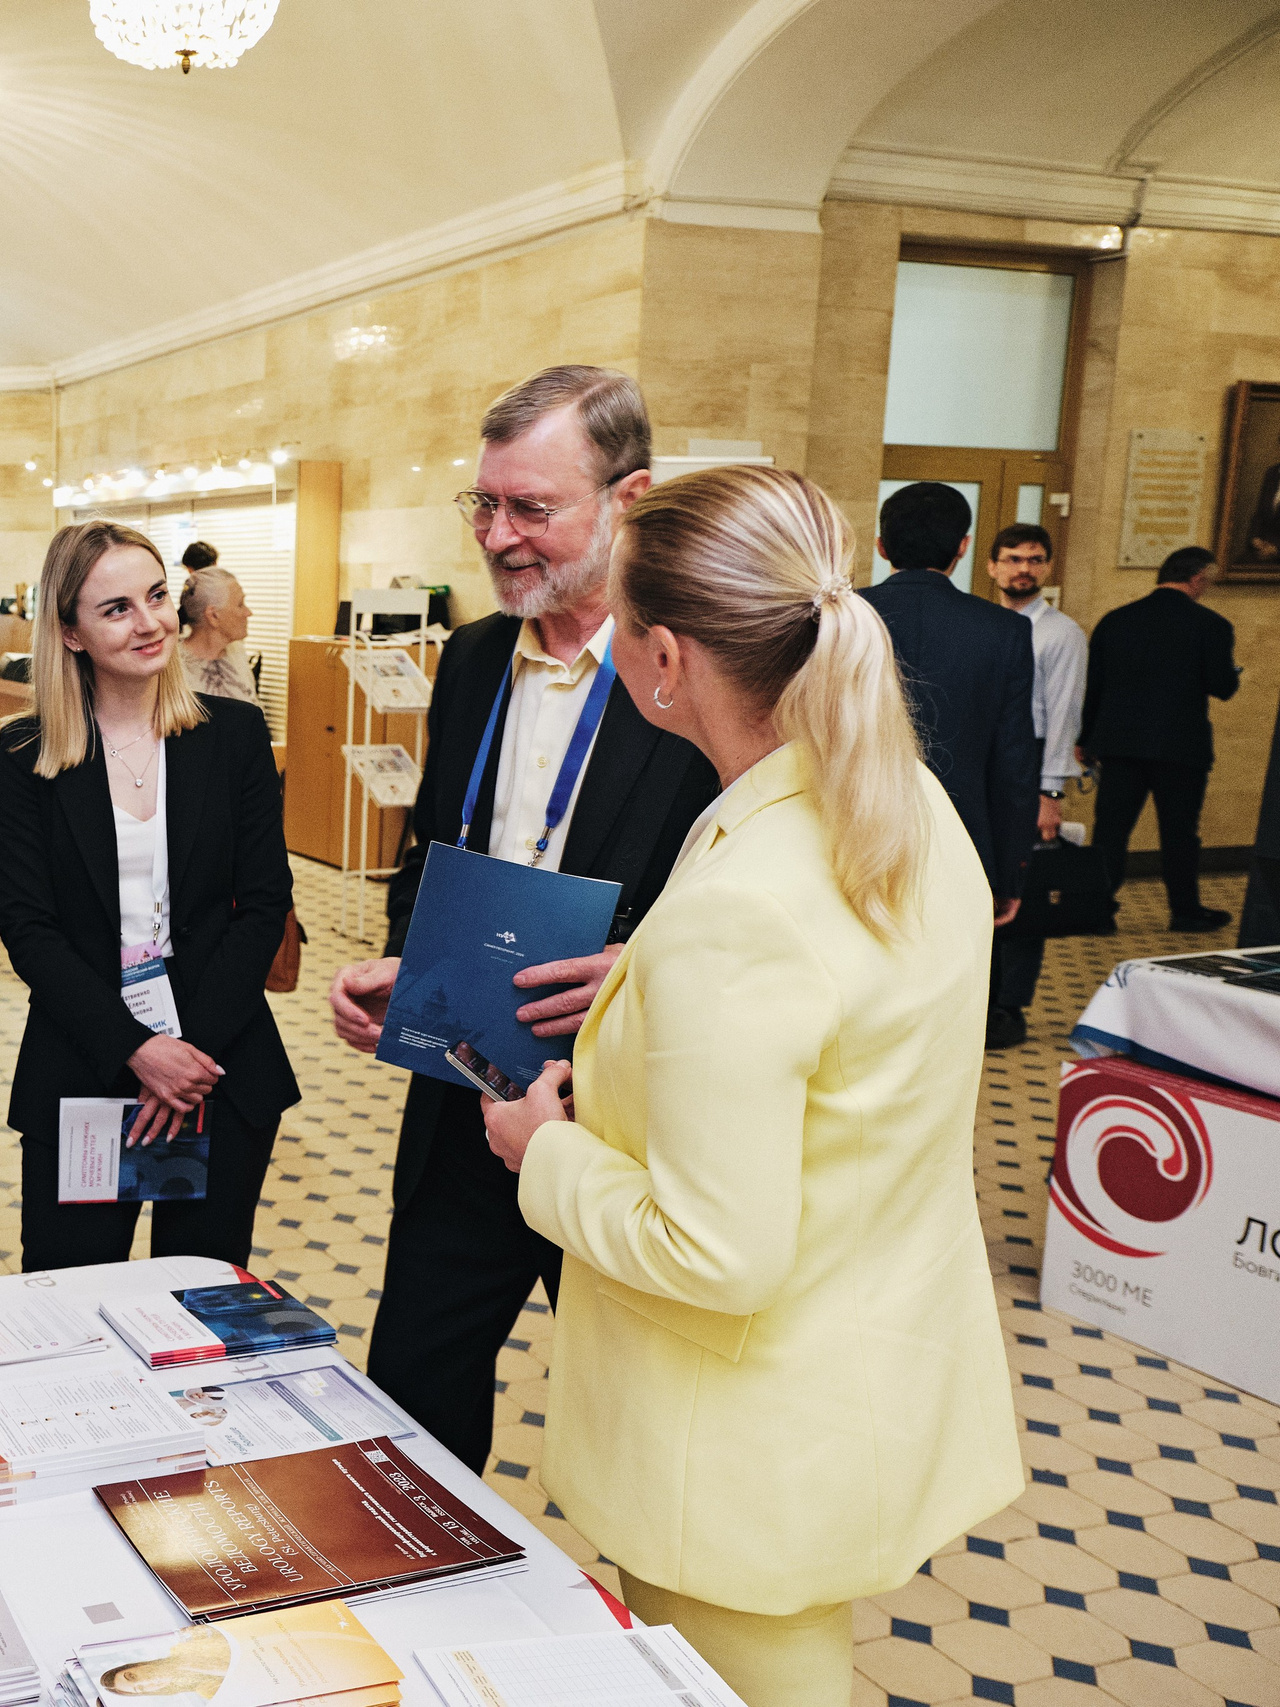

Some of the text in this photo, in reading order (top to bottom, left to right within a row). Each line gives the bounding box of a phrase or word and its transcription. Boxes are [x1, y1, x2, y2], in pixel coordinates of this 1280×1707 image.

[1072, 1260, 1153, 1308] 3000 МЕ
[202, 1480, 255, 1530] REPORTS
[388, 1472, 416, 1490] 2023
[152, 1489, 247, 1591] УРОЛОГИЧЕСКИЕ
[186, 1501, 259, 1573] ВЕДОМОСТИ
[242, 1503, 299, 1556] (St. Petersburg)
[442, 1521, 460, 1529] 13
[243, 1530, 305, 1582] UROLOGY
